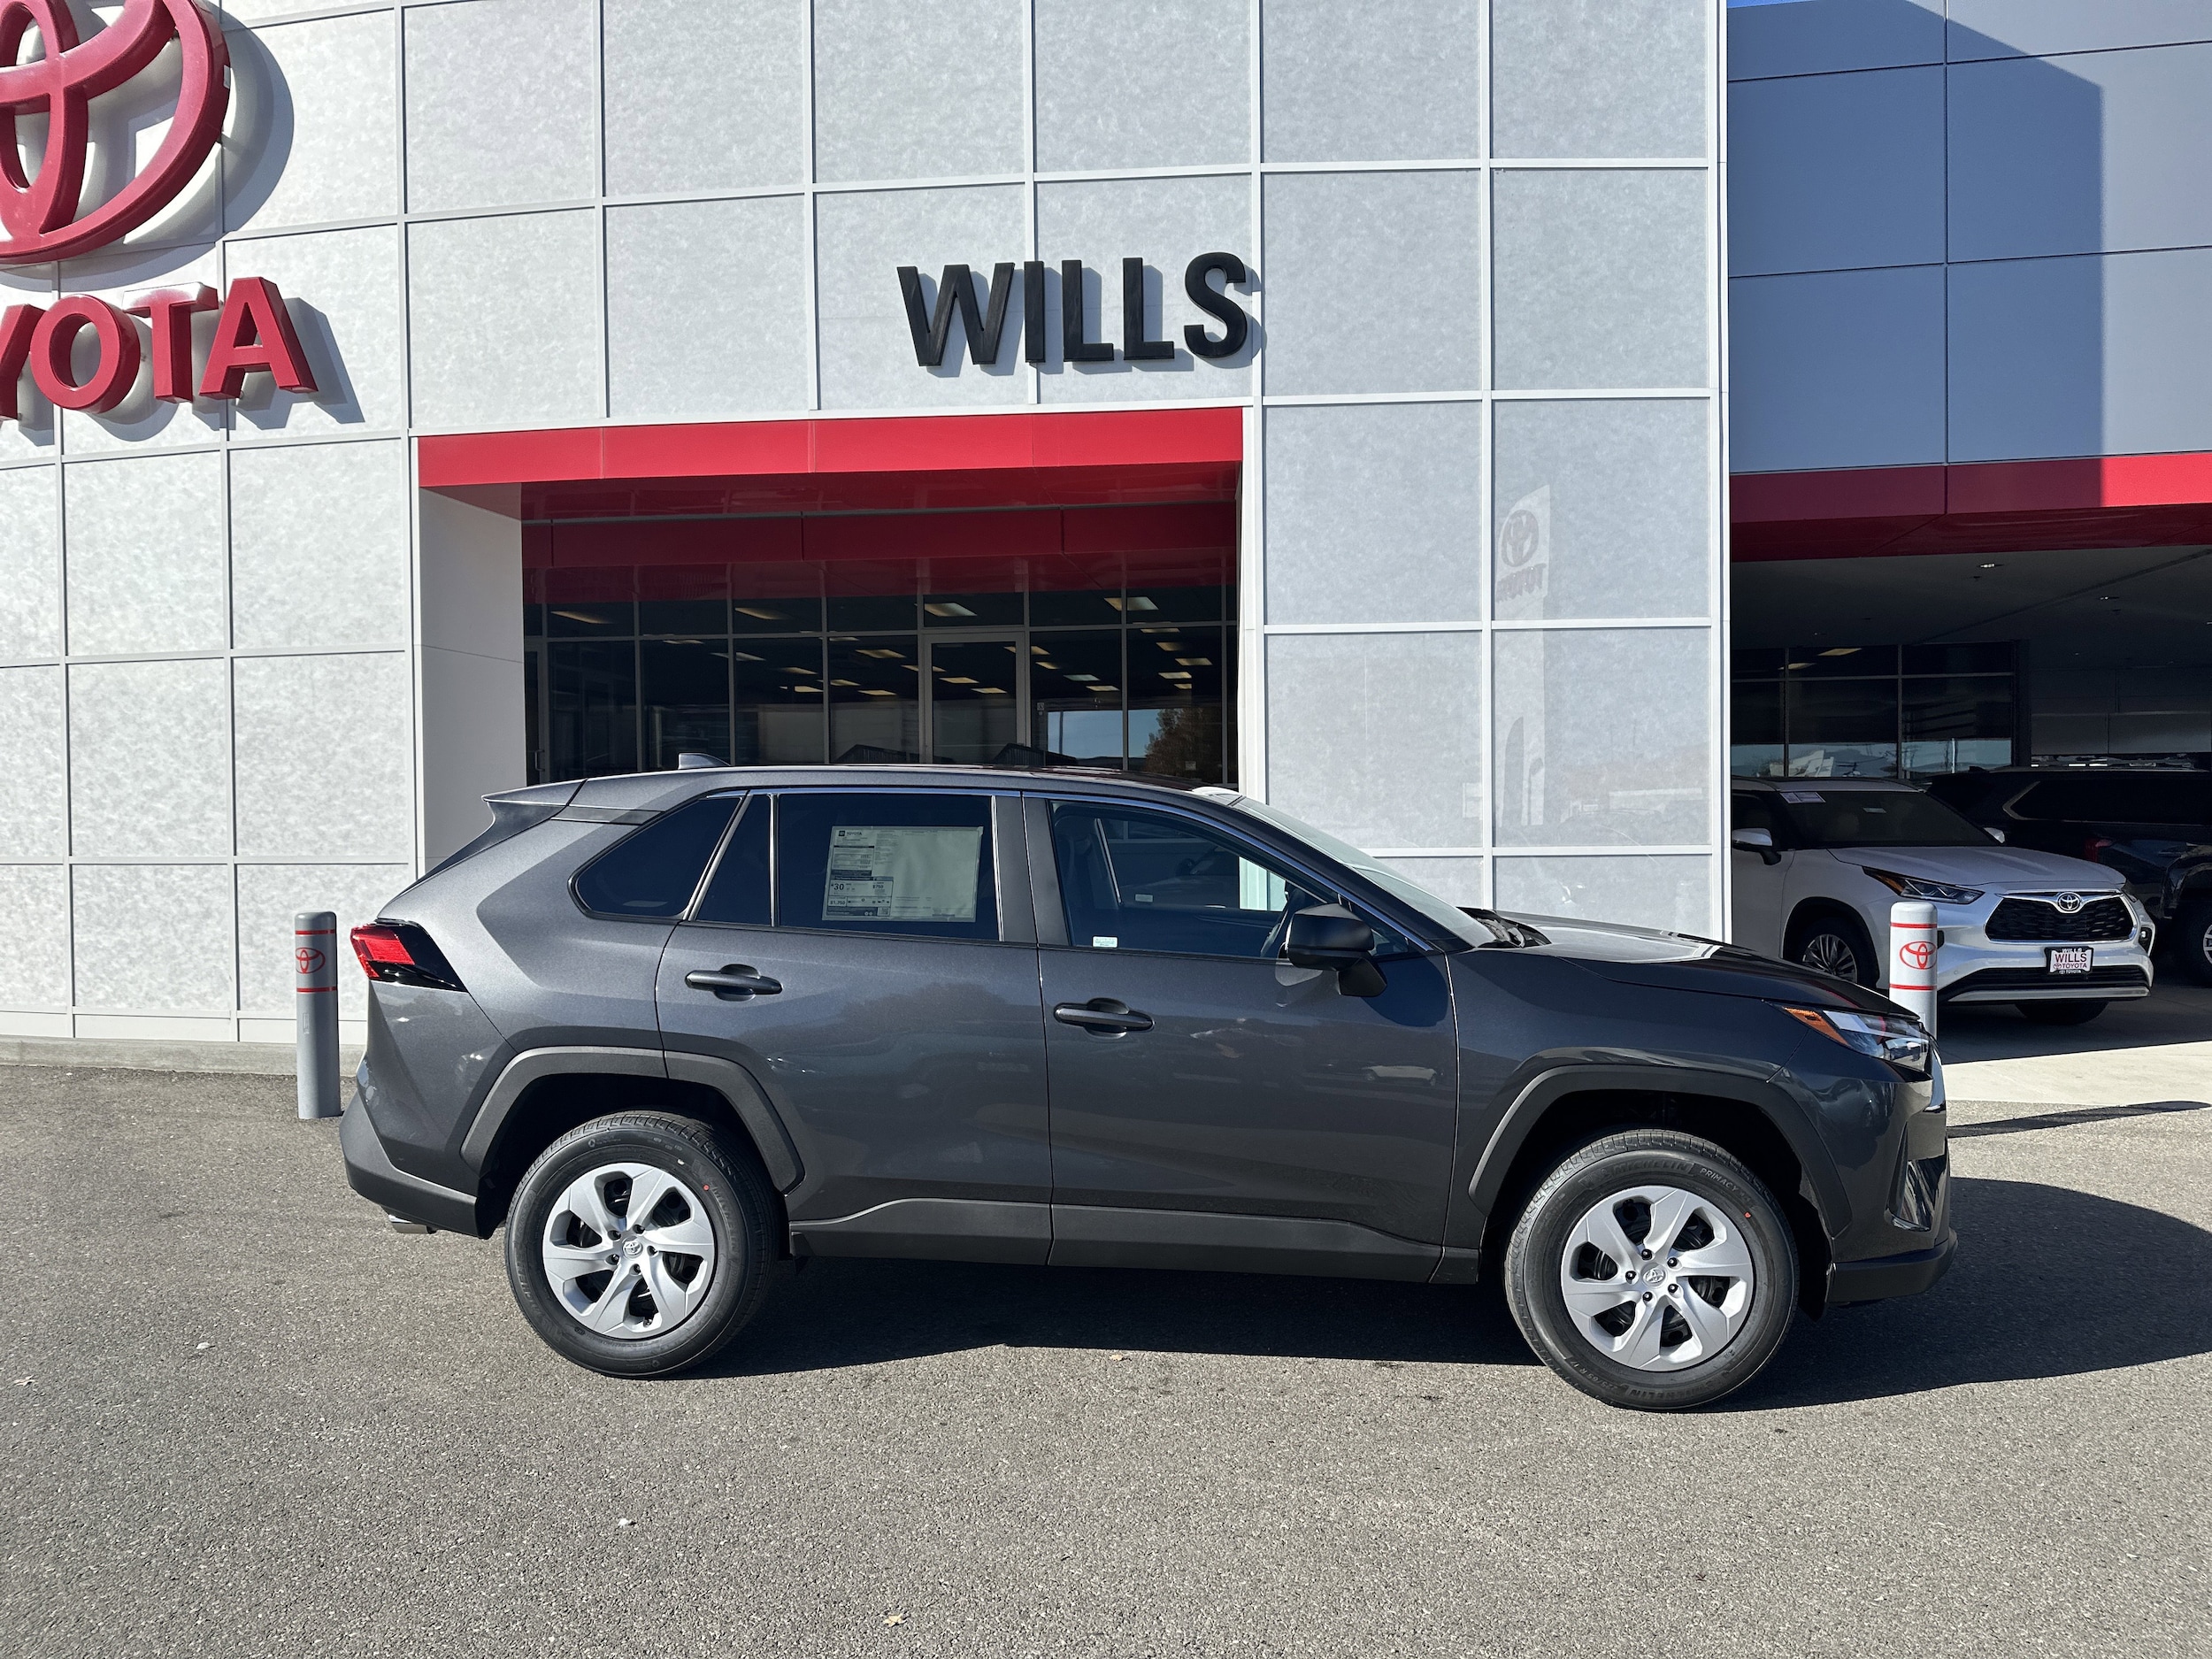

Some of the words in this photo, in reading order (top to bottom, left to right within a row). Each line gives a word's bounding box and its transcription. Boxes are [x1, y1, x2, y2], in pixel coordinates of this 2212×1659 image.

[896, 251, 1248, 366] WILLS
[833, 882, 844, 891] 30
[2055, 953, 2087, 963] WILLS
[1700, 1167, 1740, 1192] PRIMACY
